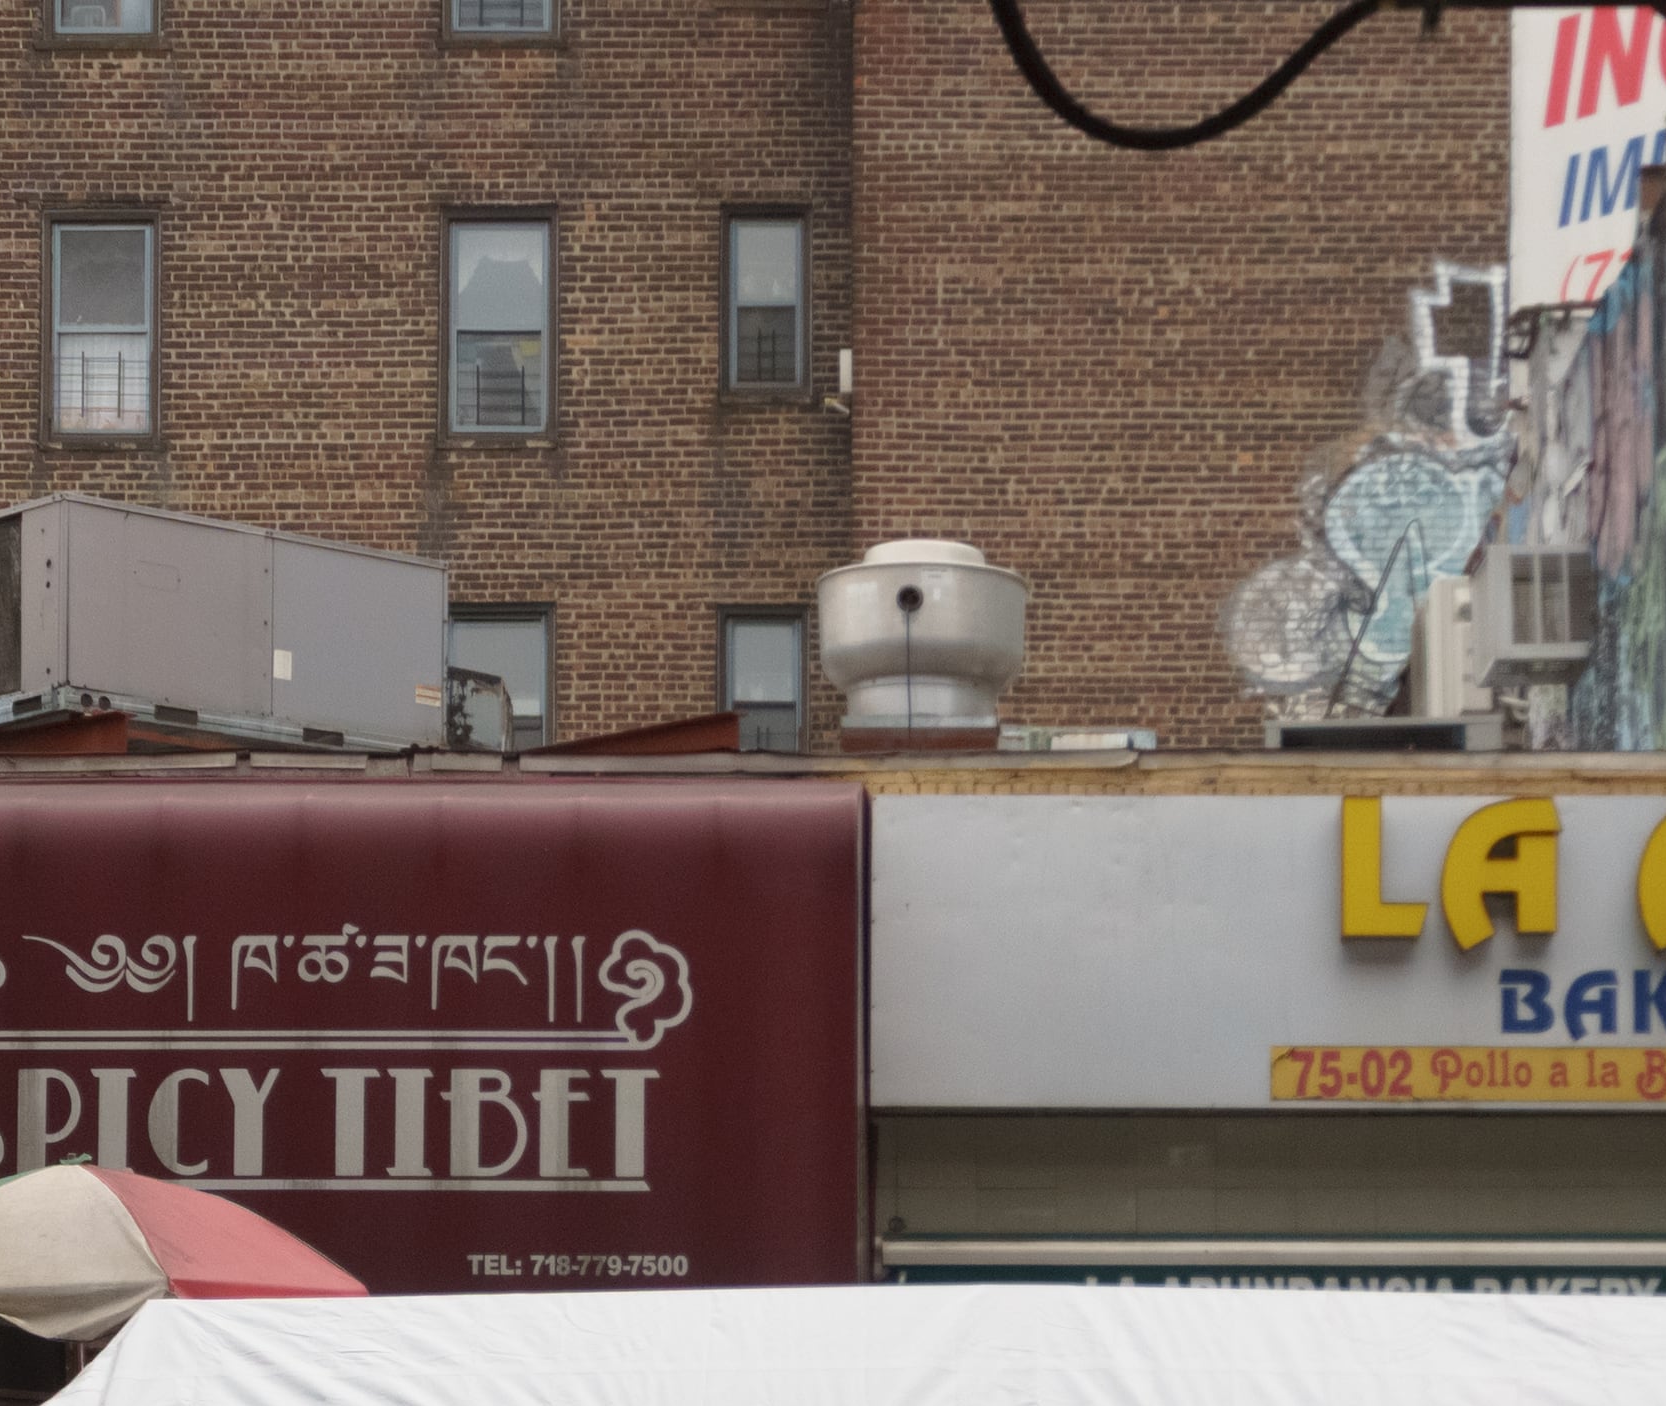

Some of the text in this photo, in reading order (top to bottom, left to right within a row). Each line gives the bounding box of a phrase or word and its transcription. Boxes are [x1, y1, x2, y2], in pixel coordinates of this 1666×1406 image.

[1339, 794, 1562, 952] LA
[1292, 1048, 1414, 1099] 75-02
[1430, 1049, 1533, 1095] Pollo
[1548, 1062, 1569, 1089] a
[1585, 1052, 1621, 1089] la
[320, 1067, 661, 1178] TIBET
[467, 1253, 690, 1279] TEL: 718-779-7500
